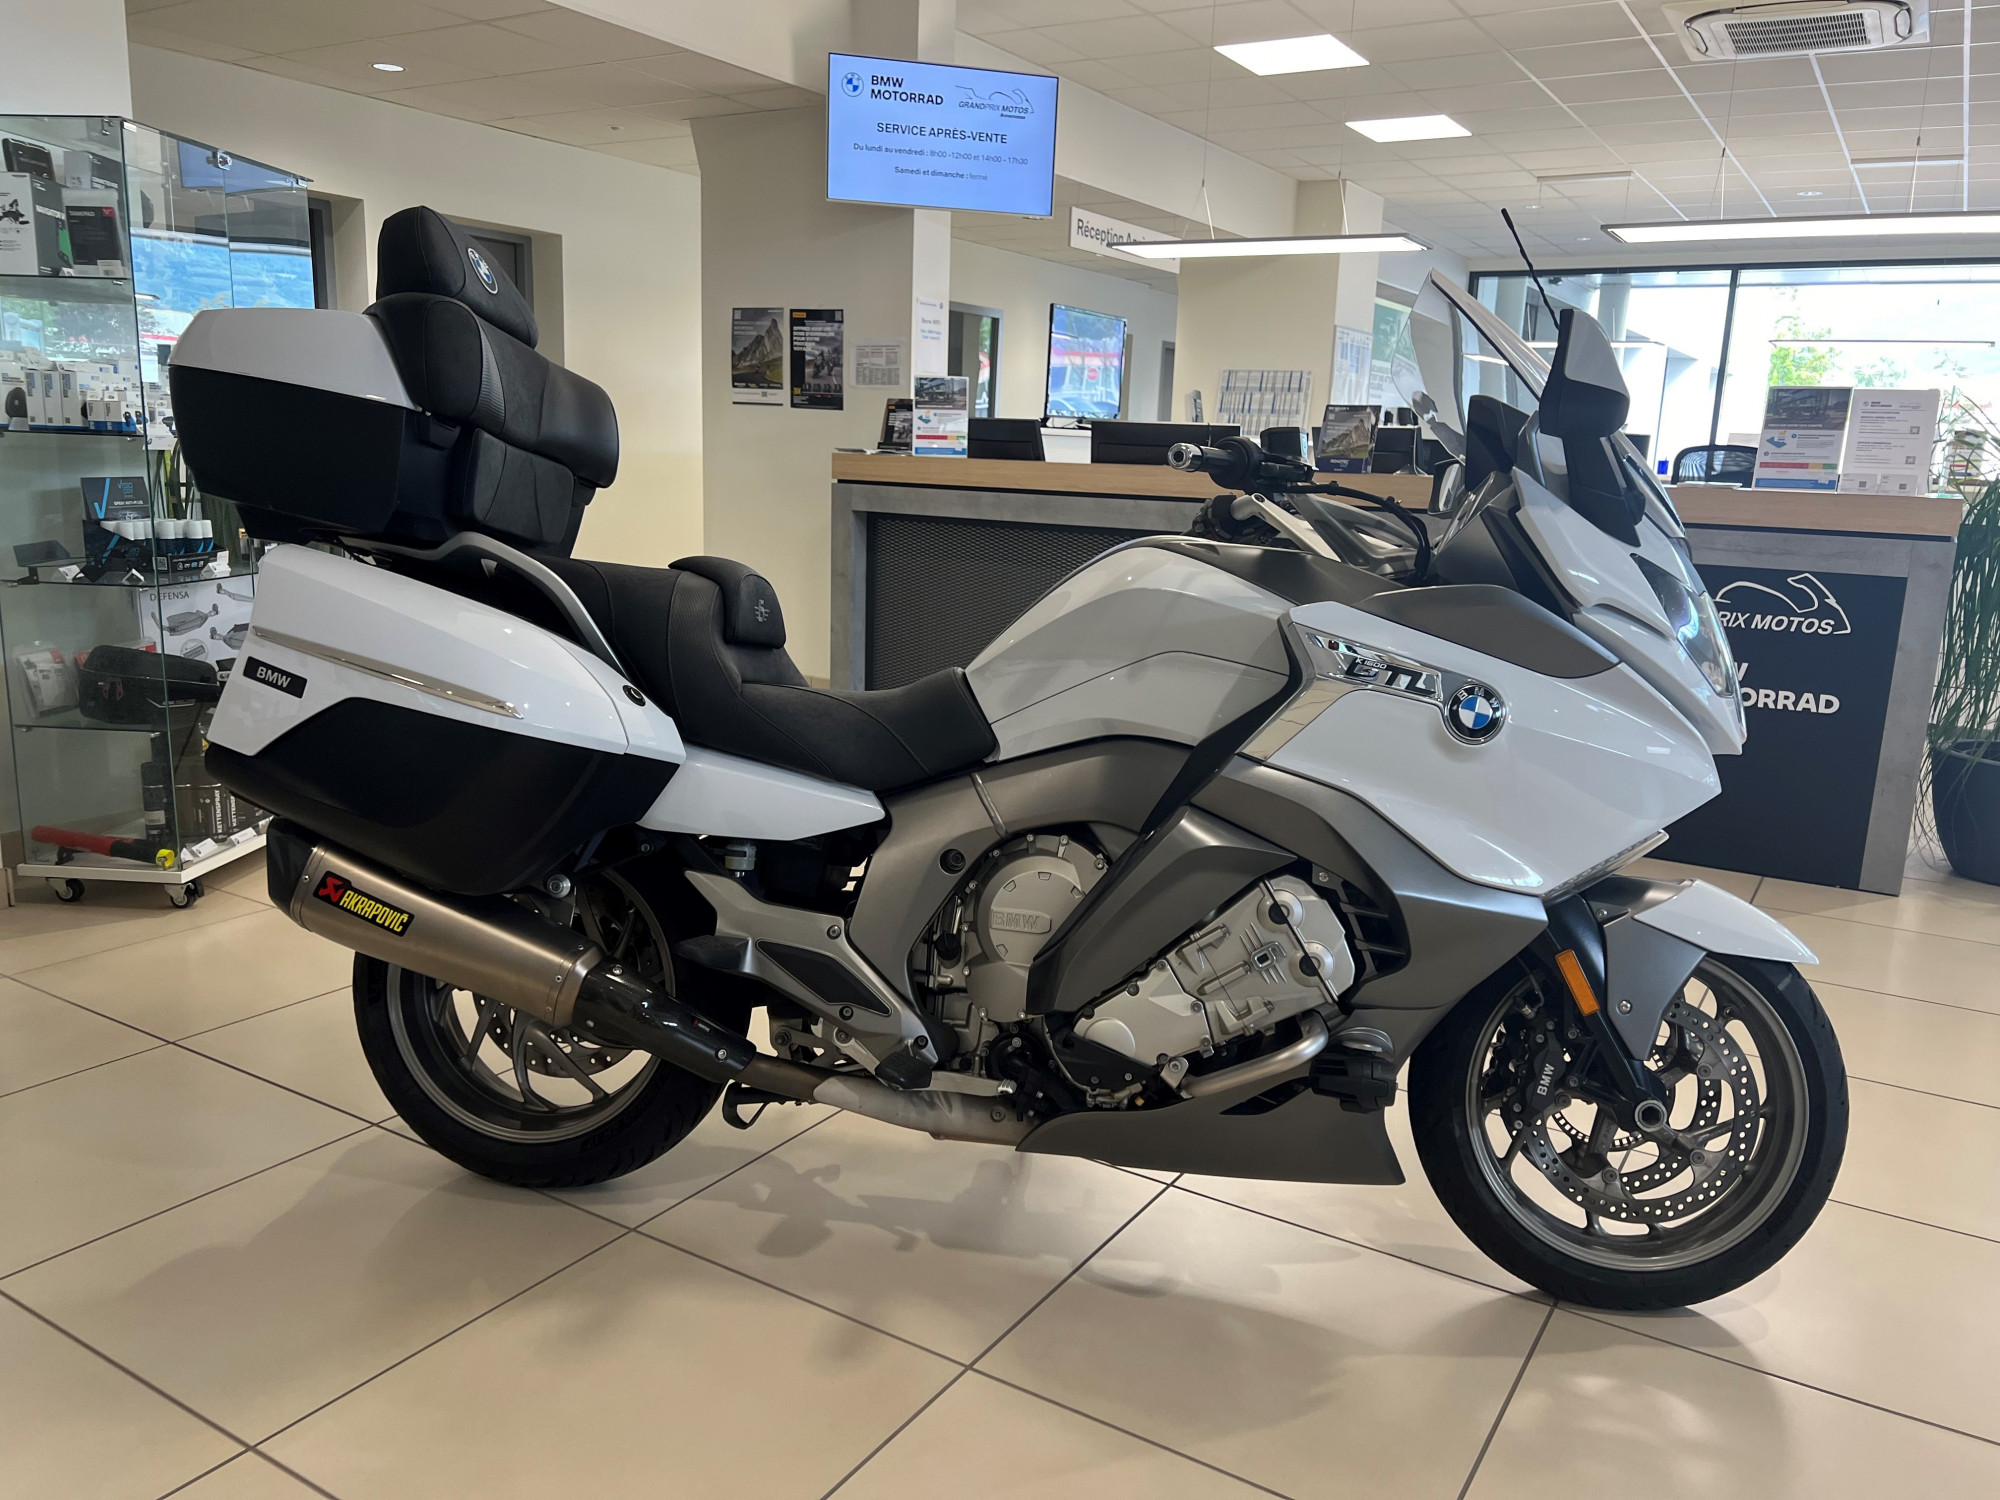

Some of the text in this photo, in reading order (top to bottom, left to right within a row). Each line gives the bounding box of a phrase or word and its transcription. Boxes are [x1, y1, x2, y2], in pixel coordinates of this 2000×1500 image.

[871, 75, 904, 88] BMW
[870, 88, 944, 106] MOTORRAD
[1001, 105, 1029, 114] MOTOS
[876, 122, 1008, 144] SERVICE APRÈS-VENTE
[853, 143, 864, 151] Du
[865, 144, 883, 152] lundi
[894, 147, 925, 156] vendredi
[894, 166, 921, 175] Samedi
[930, 169, 965, 179] dimanche
[1077, 218, 1124, 246] Réception
[1717, 611, 1835, 635] RIX MOTOS
[256, 666, 292, 688] BMW
[1740, 687, 1841, 714] ORRAD
[992, 910, 1040, 930] BMW
[1536, 1063, 1555, 1096] BMW
